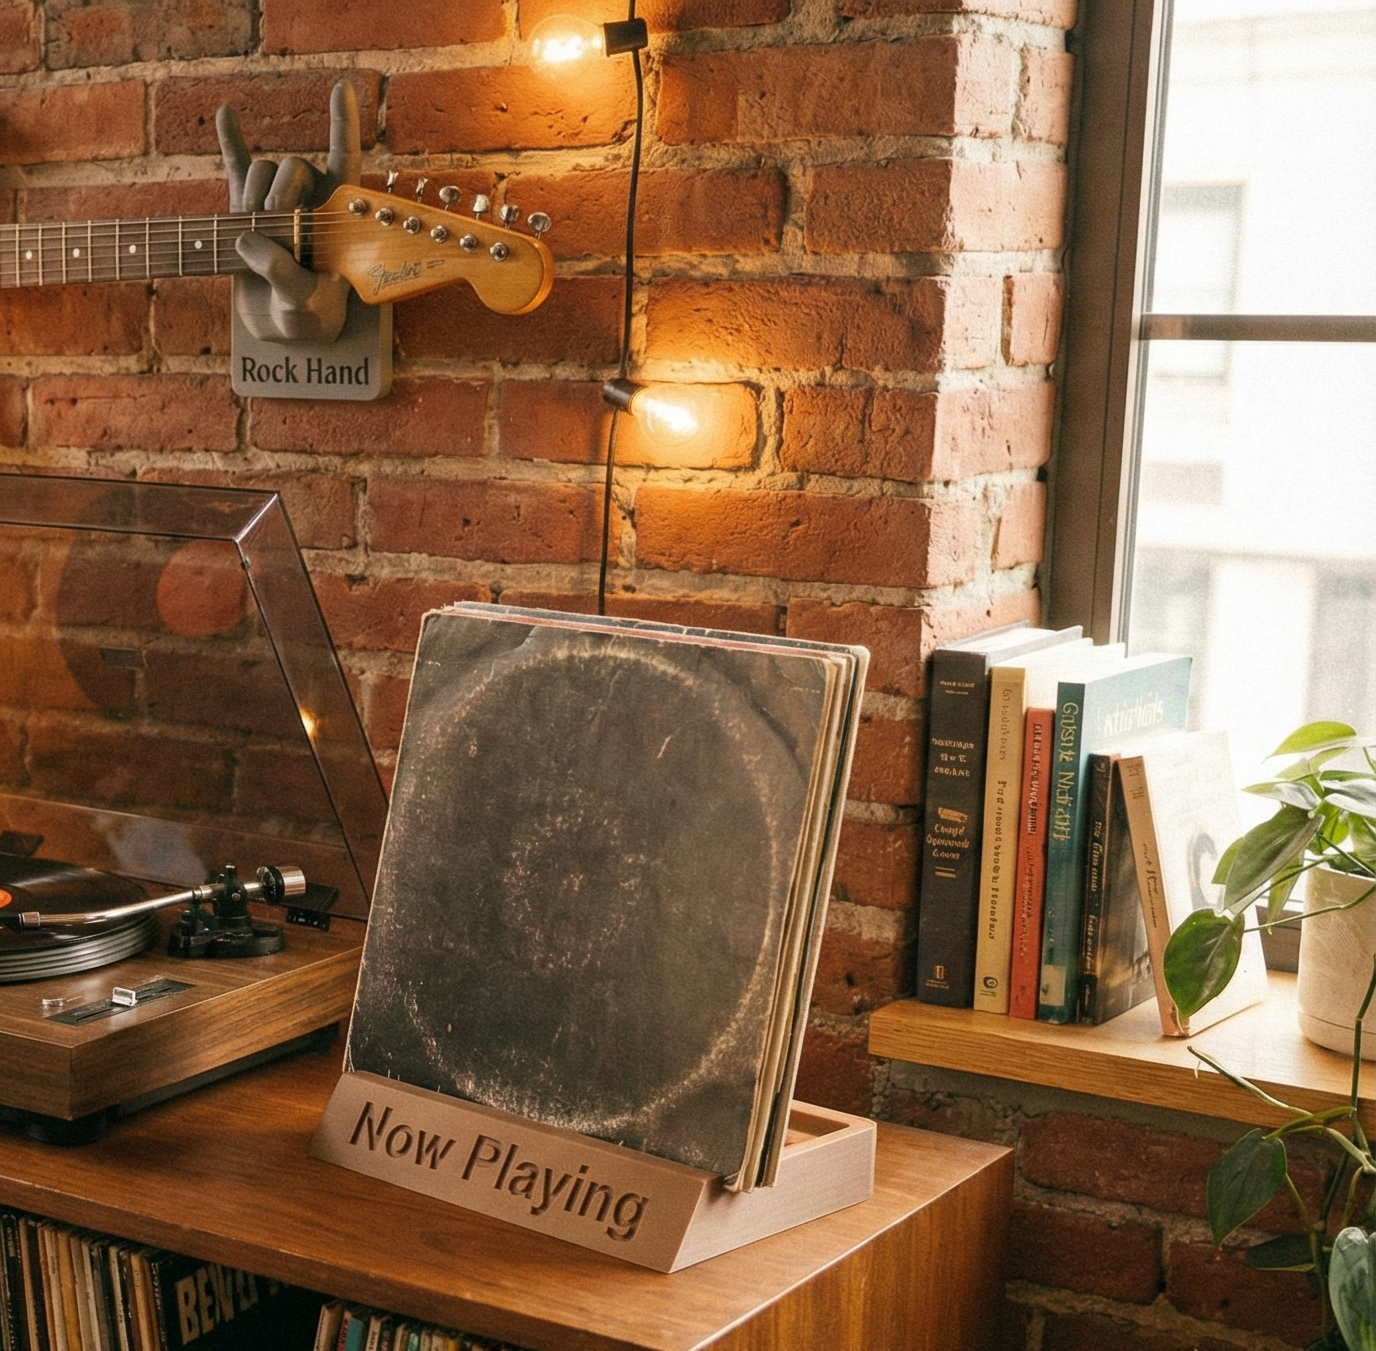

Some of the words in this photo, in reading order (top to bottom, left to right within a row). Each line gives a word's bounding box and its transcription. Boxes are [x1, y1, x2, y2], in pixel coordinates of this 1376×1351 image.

[241, 356, 299, 384] Rock
[306, 357, 370, 386] Hand
[348, 1101, 457, 1171] Now
[461, 1133, 651, 1243] Playing
